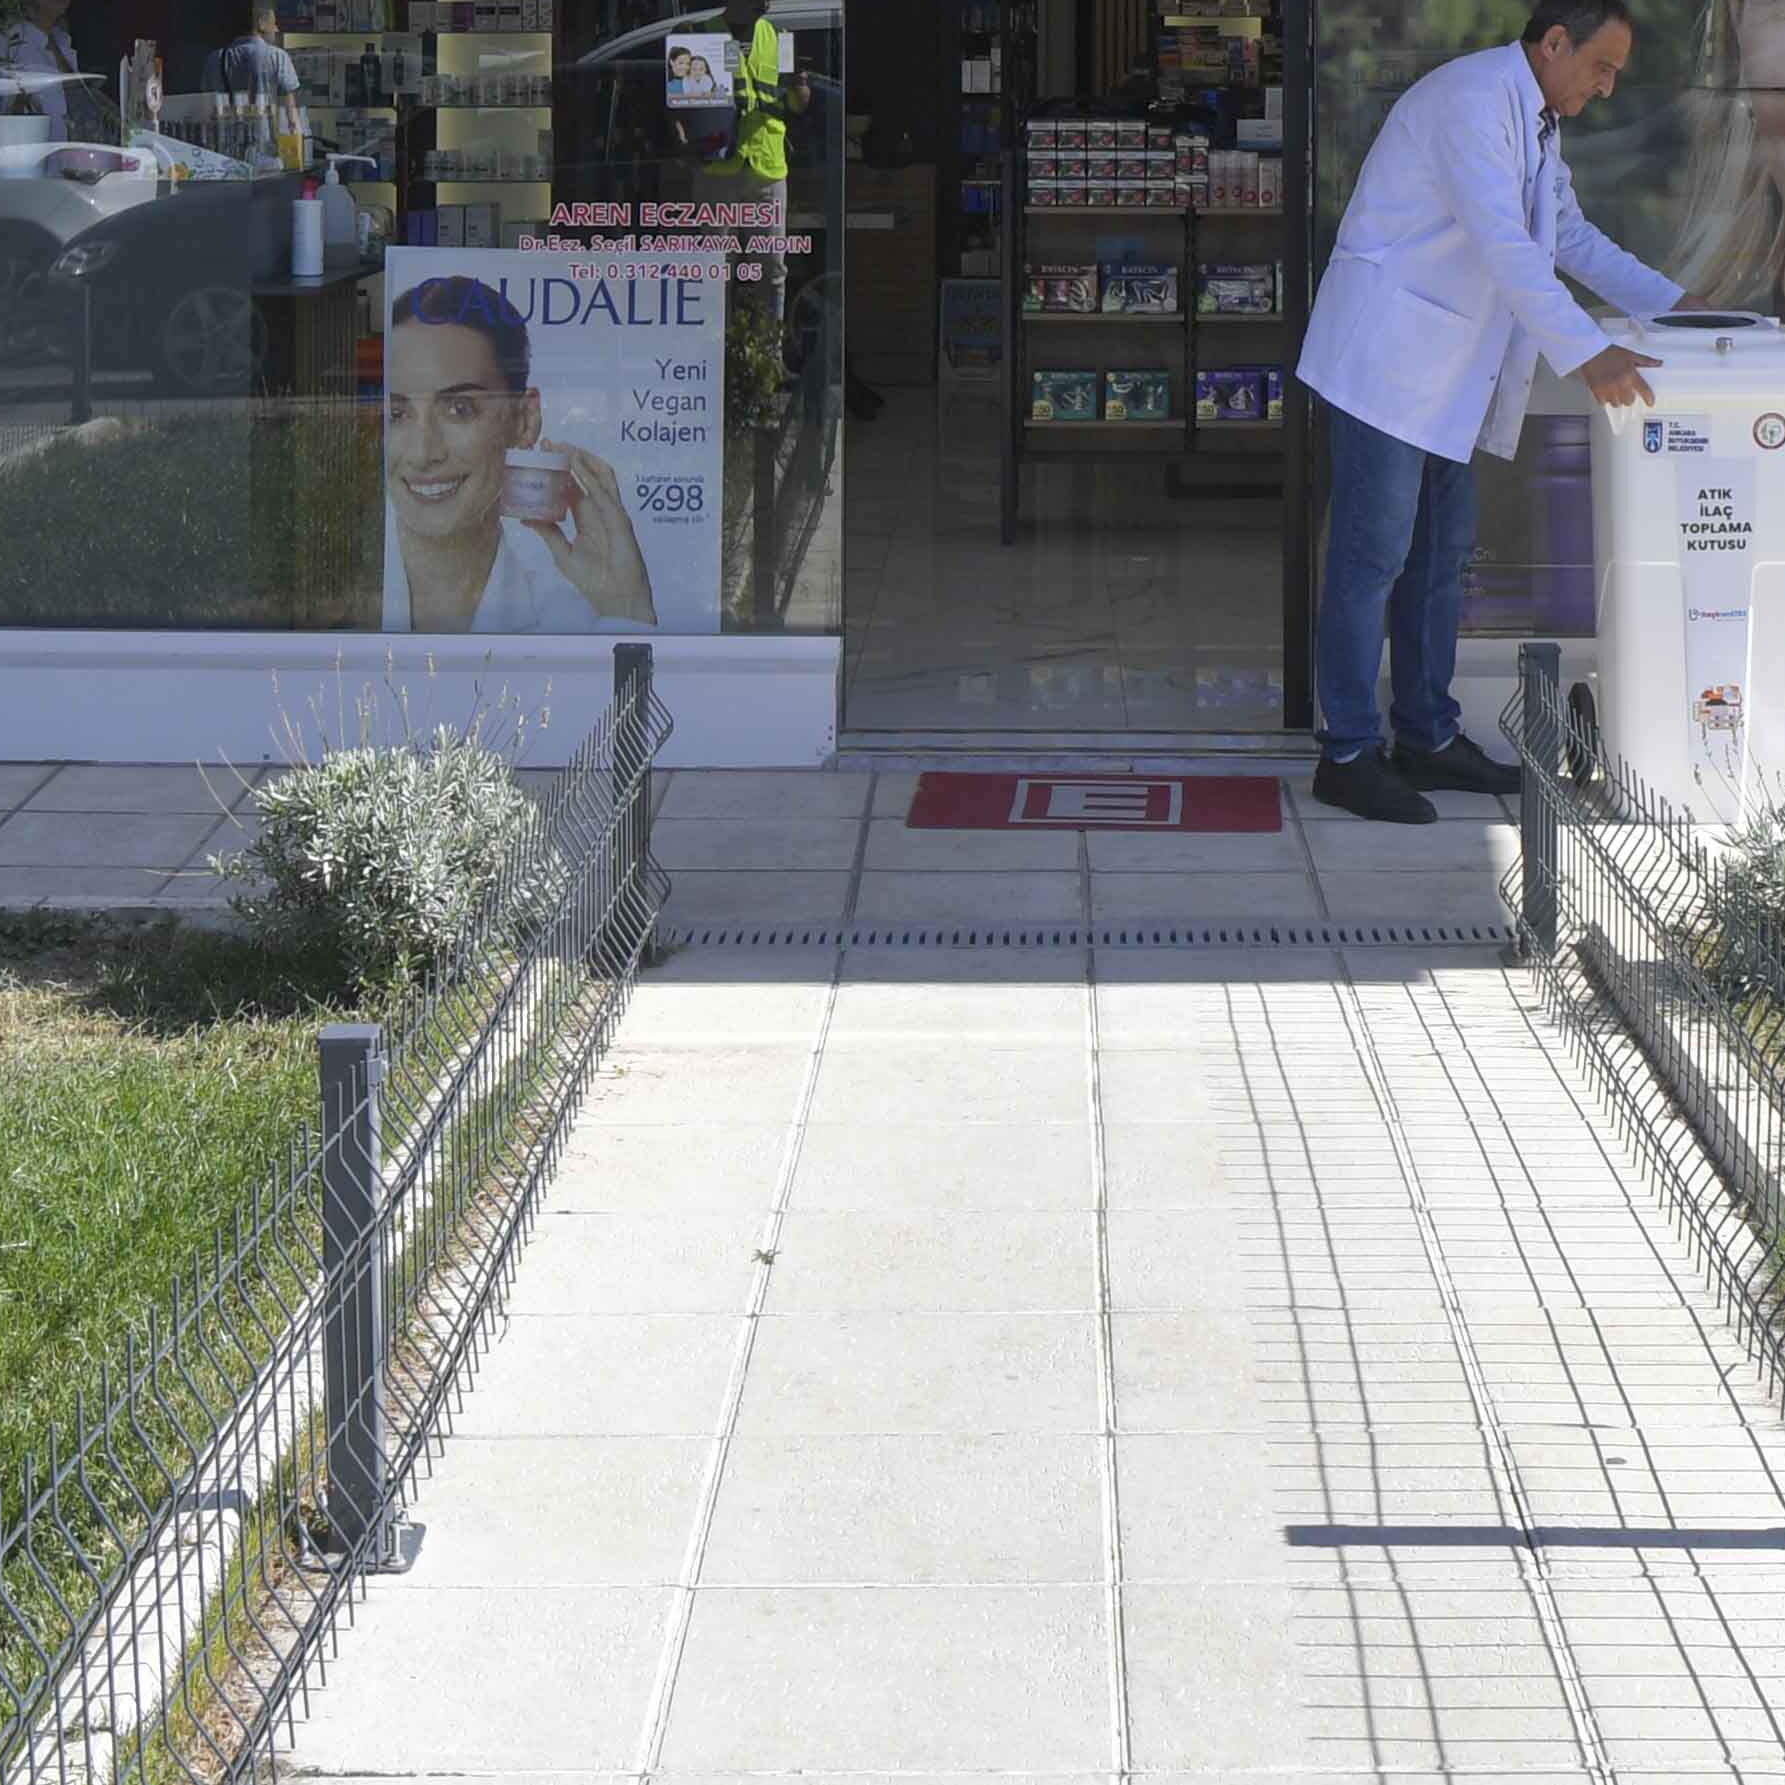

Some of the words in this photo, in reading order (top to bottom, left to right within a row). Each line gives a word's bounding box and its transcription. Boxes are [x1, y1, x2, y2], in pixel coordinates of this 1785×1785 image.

[550, 203, 631, 227] AREN
[640, 199, 785, 228] ECZANESİ
[592, 234, 636, 255] Seçil
[641, 235, 741, 254] SARIKAYA
[746, 235, 812, 254] AYDIN
[568, 263, 600, 280] Tel:
[607, 263, 659, 281] 0.312
[665, 263, 702, 281] 440
[708, 263, 731, 280] 01
[737, 263, 762, 281] 05
[656, 359, 707, 381] Yeni
[633, 390, 706, 417] Vegan
[620, 420, 706, 447] Kolajen
[637, 484, 703, 511] %98
[1698, 488, 1732, 500] ATIK
[1700, 503, 1733, 520] İLAÇ
[1680, 522, 1752, 534] TOPLAMA
[1687, 539, 1746, 551] KUTUSU
